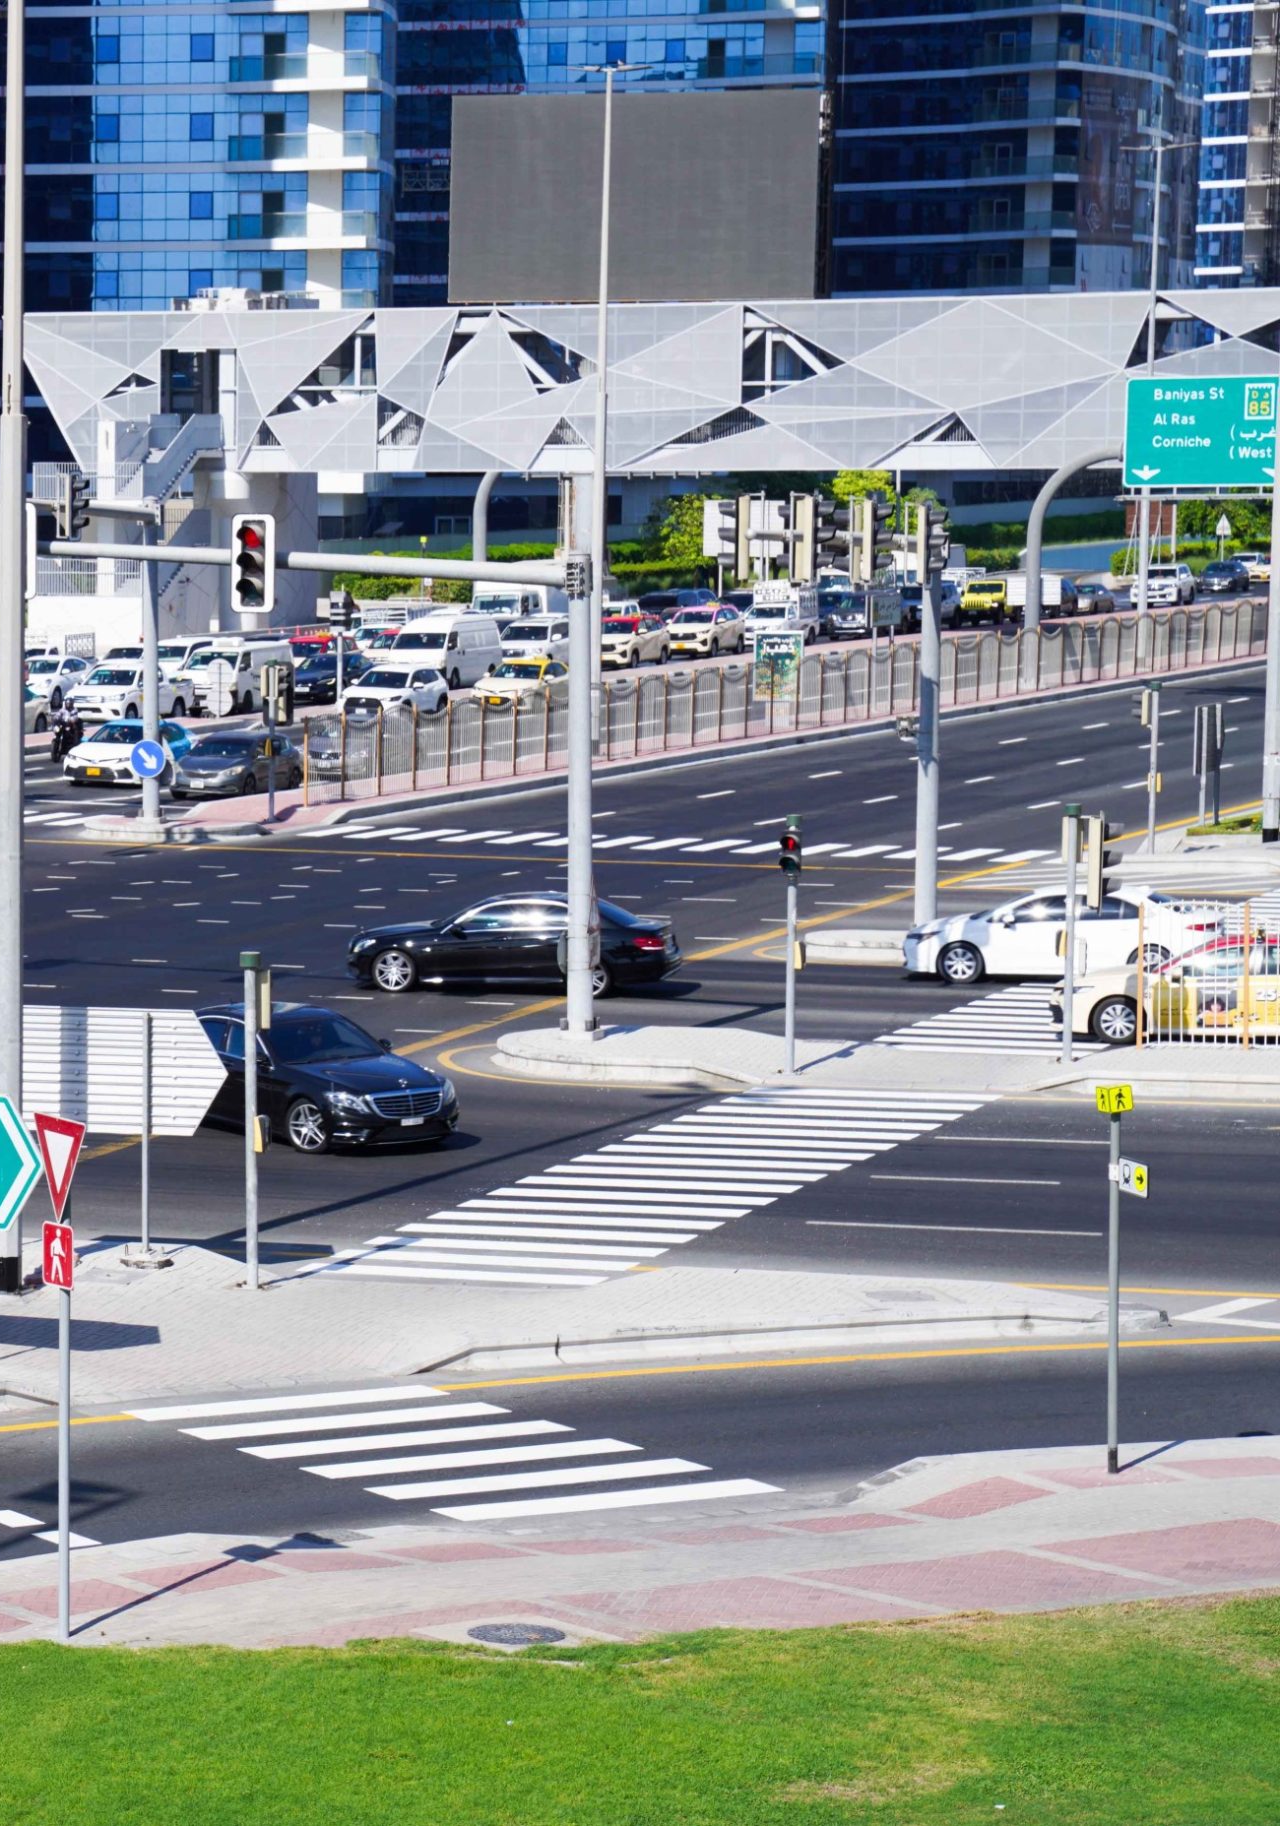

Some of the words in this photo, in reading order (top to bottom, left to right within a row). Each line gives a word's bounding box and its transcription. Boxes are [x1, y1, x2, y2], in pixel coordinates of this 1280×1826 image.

[1153, 388, 1205, 403] Baniyas
[1209, 387, 1224, 400] St
[1249, 400, 1270, 416] 85
[1153, 413, 1167, 425] Al
[1171, 413, 1196, 425] Ras
[1152, 435, 1211, 448] Corniche
